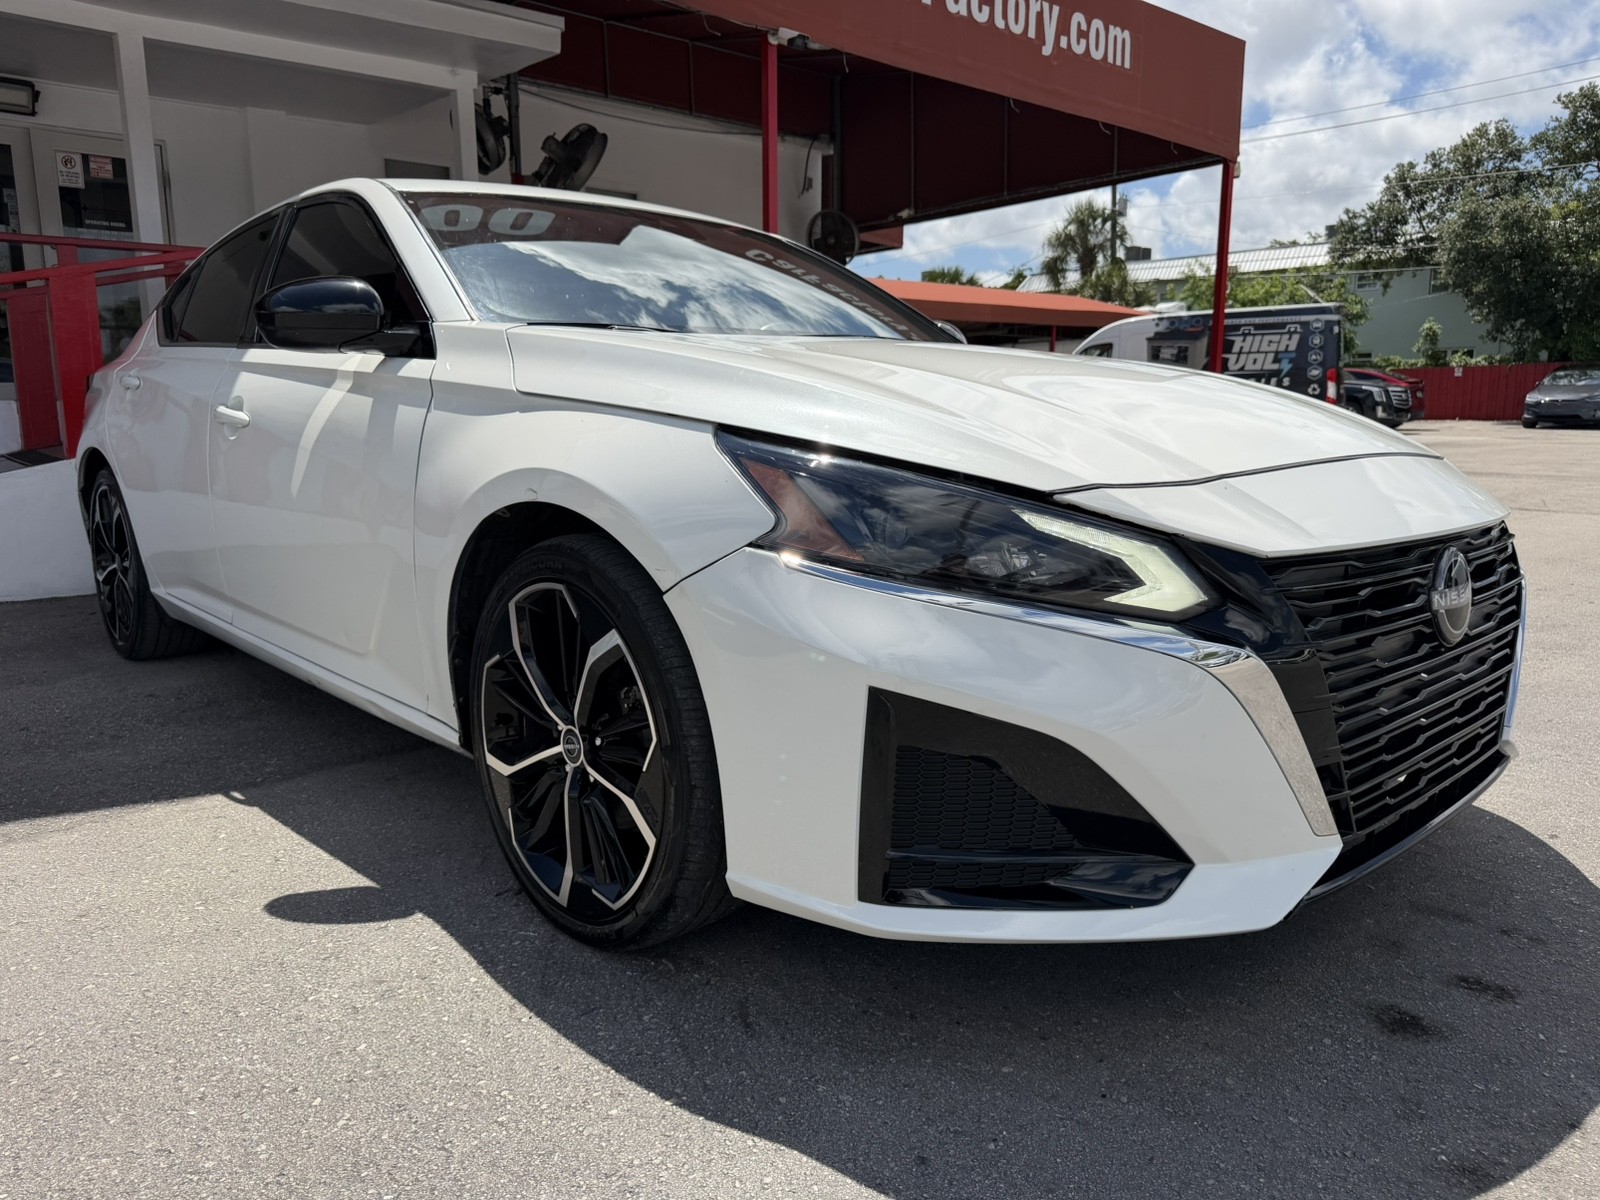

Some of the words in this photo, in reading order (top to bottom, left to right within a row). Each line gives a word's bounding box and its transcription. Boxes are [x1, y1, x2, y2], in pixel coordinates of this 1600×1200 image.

[921, 0, 1131, 70] ctory.com
[1224, 333, 1300, 353] HIGH
[1221, 352, 1296, 378] VOLT
[1433, 589, 1470, 608] NISS
